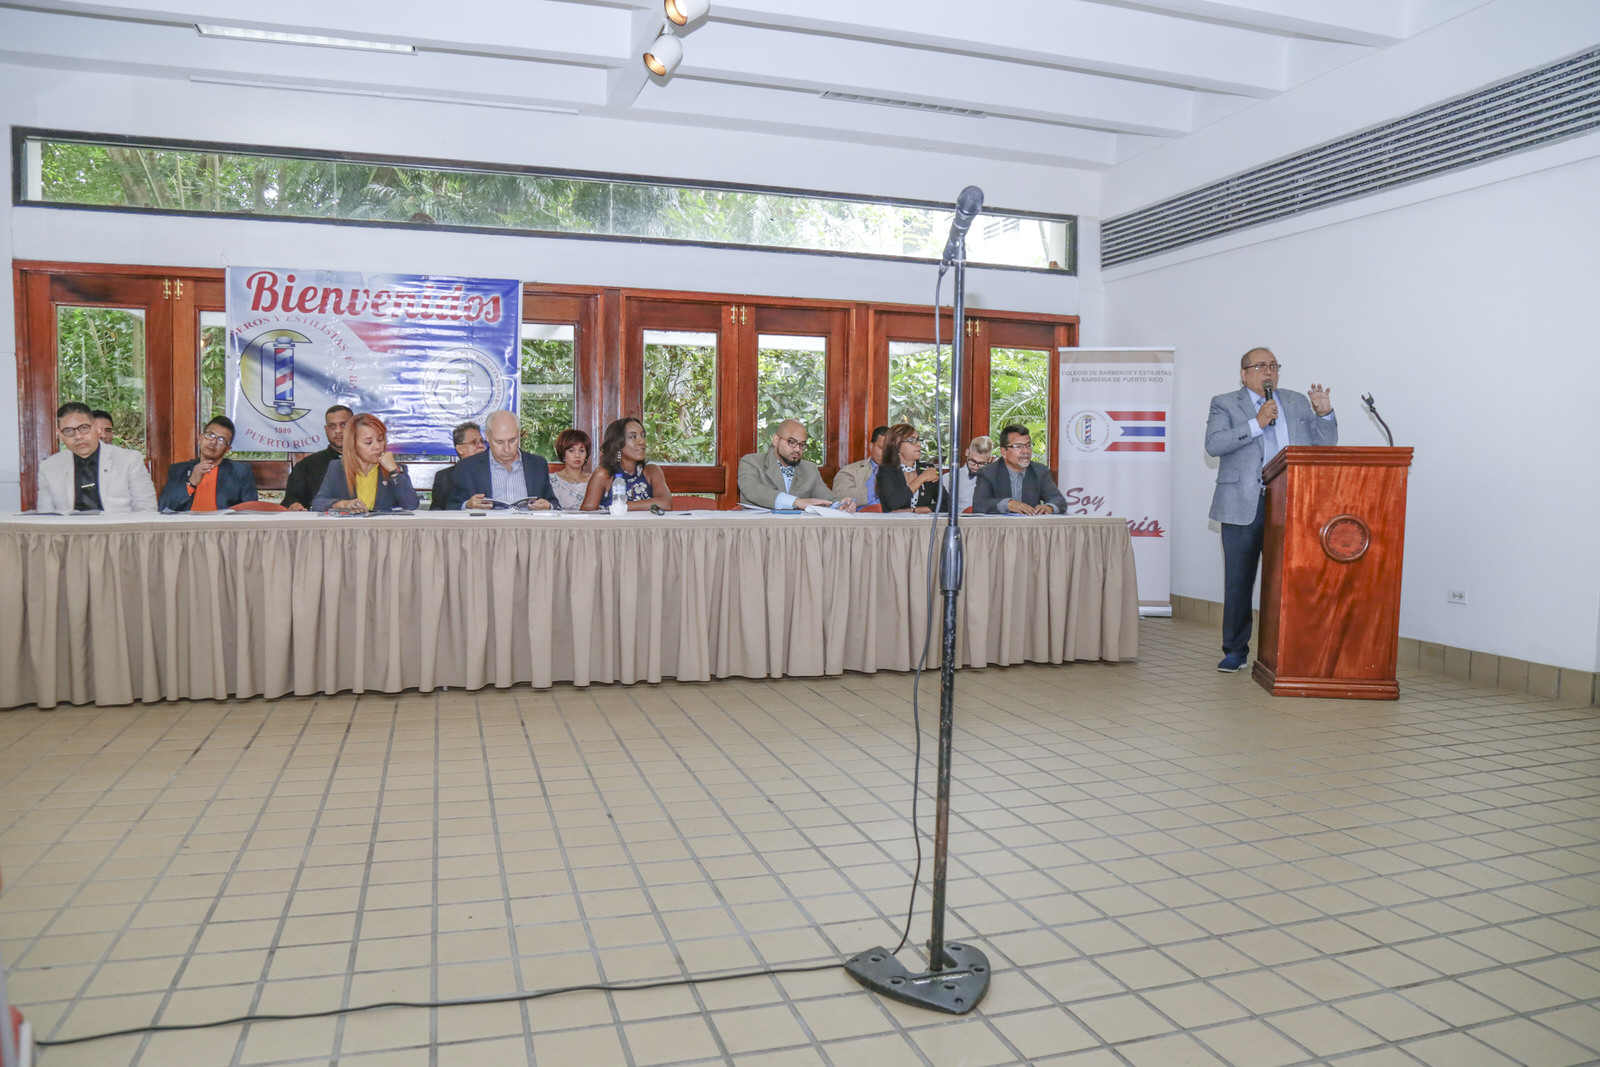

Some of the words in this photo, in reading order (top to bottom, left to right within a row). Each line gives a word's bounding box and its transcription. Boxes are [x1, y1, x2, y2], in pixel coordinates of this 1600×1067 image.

[246, 271, 501, 322] Bienvenidos
[244, 428, 290, 449] PUERTO
[292, 434, 320, 449] RICO
[274, 427, 292, 435] 1989
[1066, 487, 1105, 512] Soy
